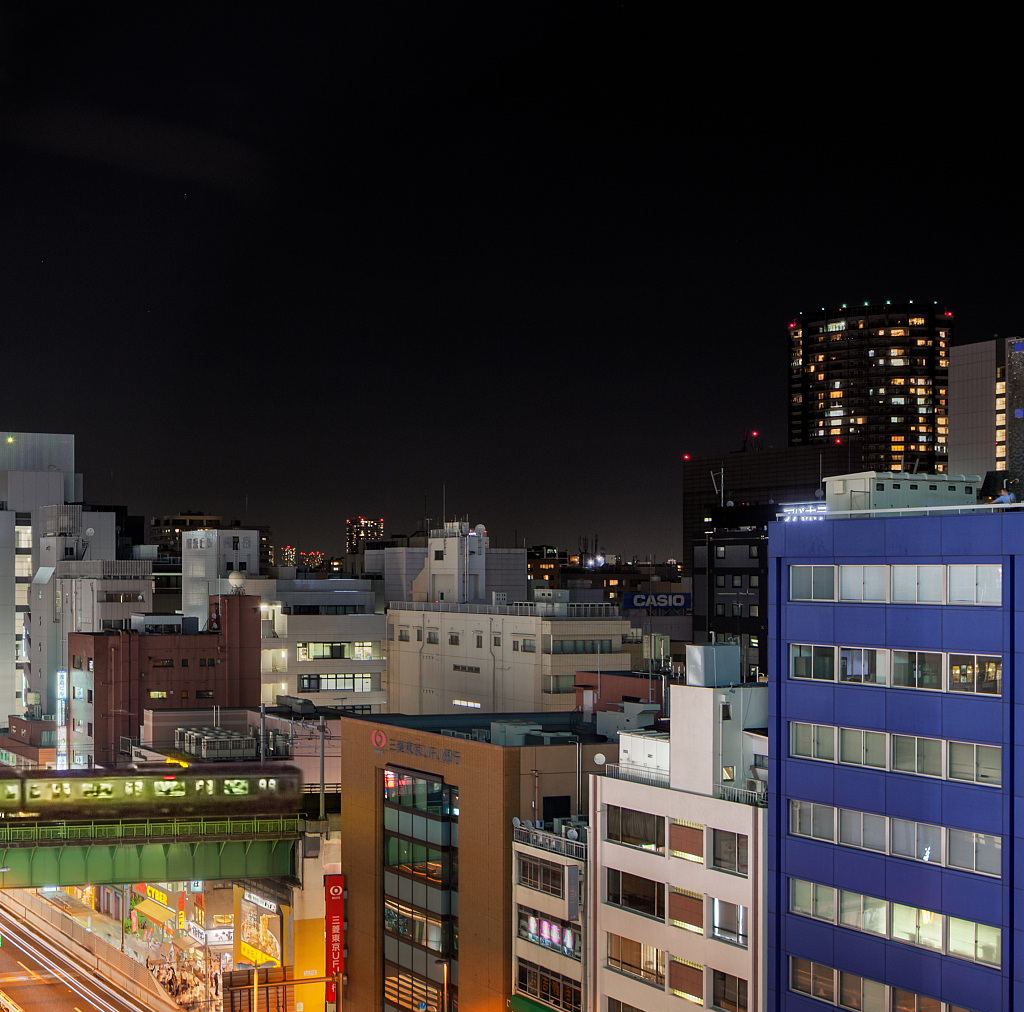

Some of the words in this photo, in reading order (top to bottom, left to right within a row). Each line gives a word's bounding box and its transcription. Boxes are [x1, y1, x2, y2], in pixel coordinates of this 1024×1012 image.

[633, 594, 685, 607] CASIO
[389, 738, 461, 765] 三菱東京UFJ銀行
[146, 885, 168, 906] CYBER
